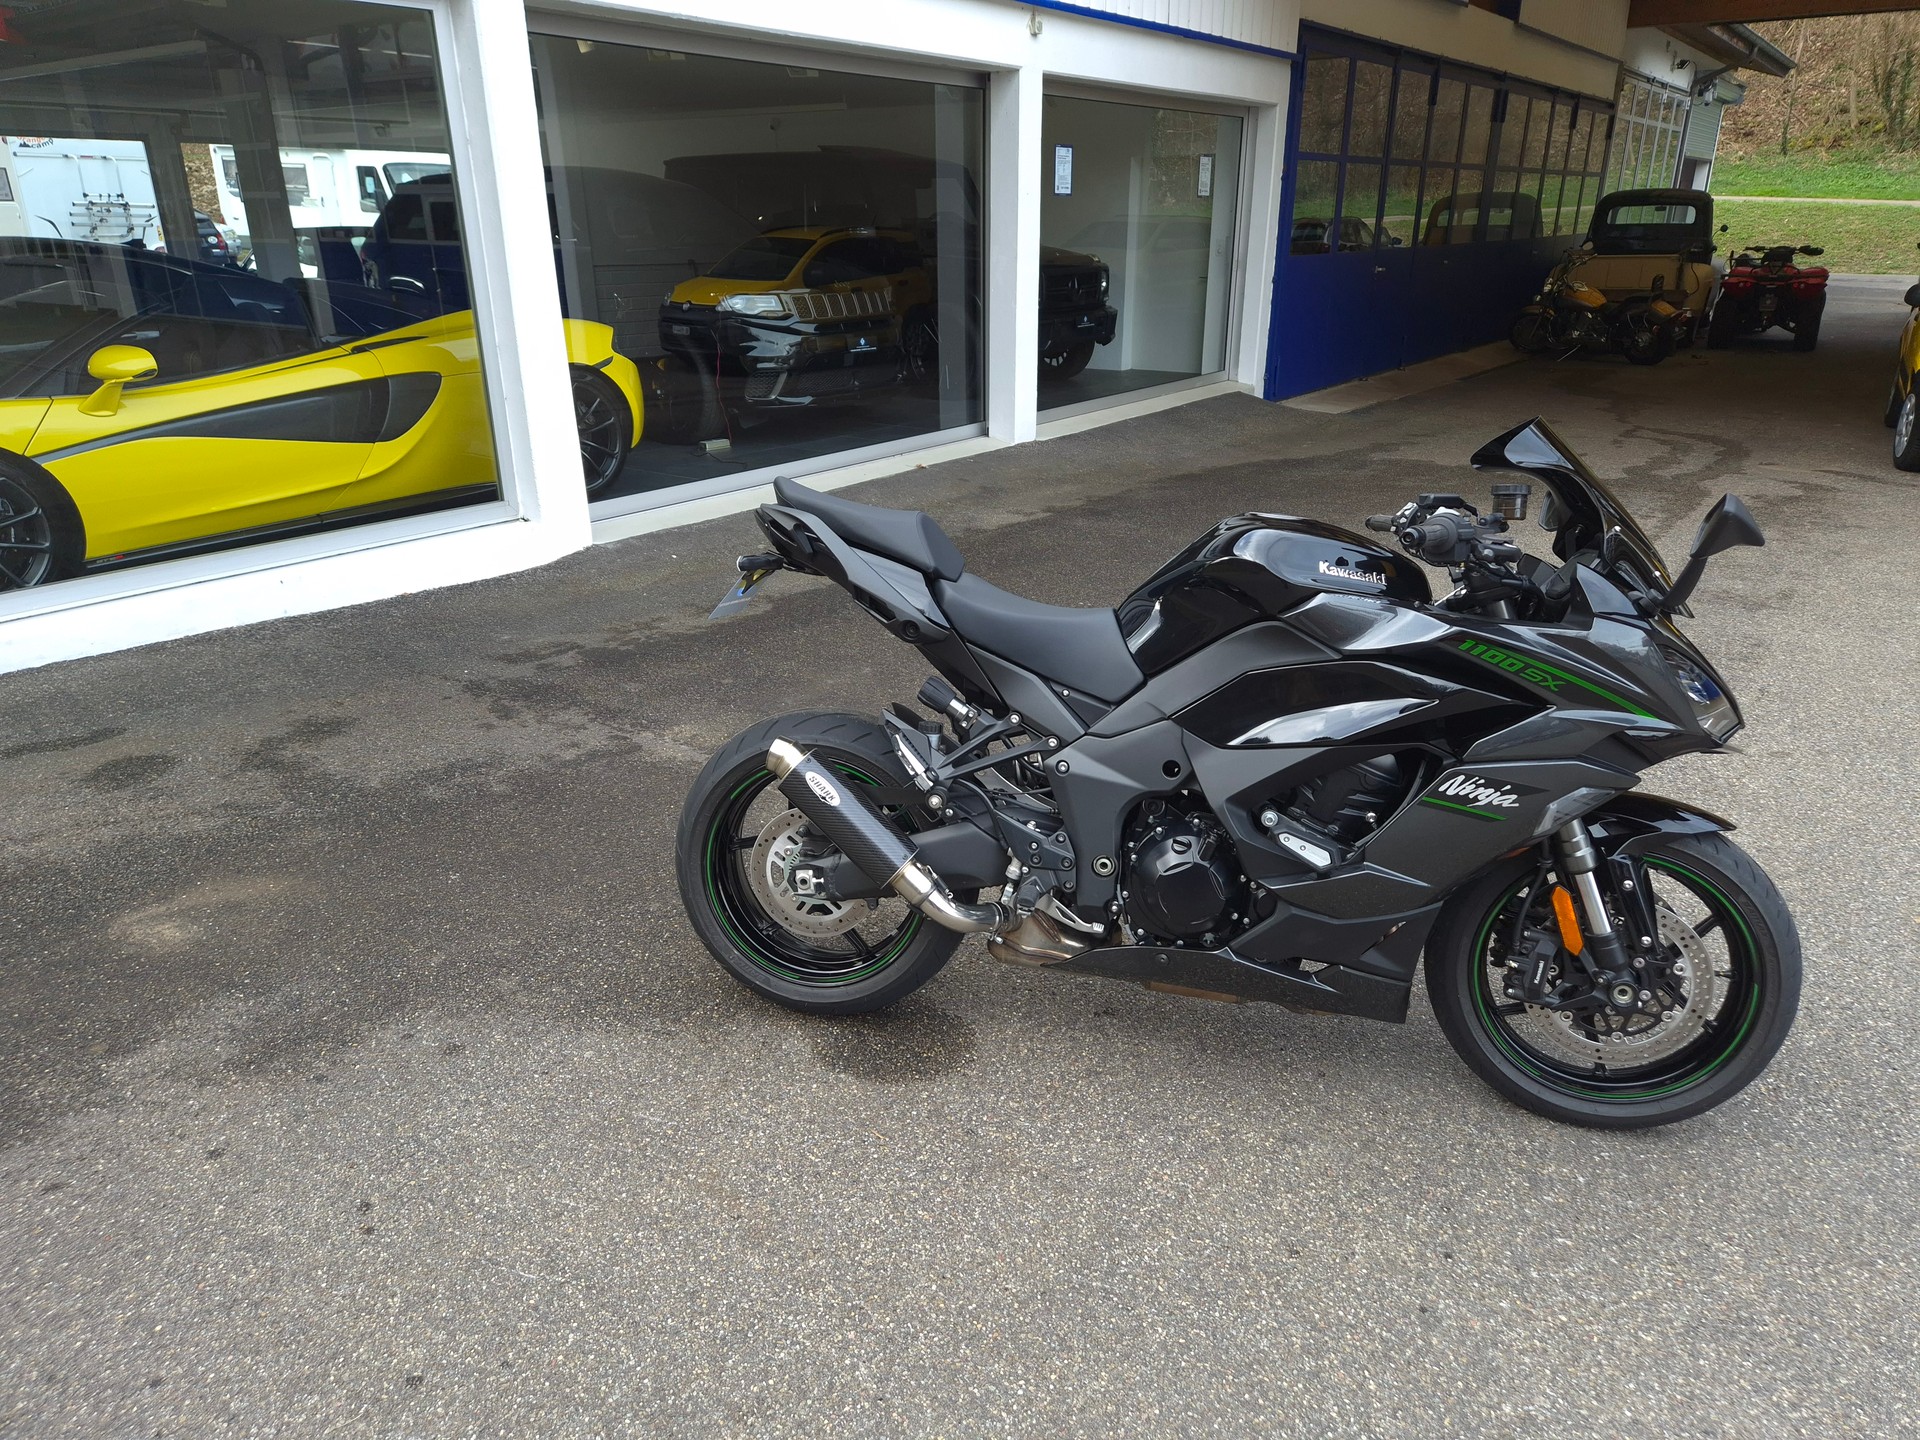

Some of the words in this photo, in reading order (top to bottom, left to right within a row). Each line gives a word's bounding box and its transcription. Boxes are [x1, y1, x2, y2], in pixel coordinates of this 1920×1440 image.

[1318, 560, 1388, 586] Kawasaki
[809, 775, 837, 802] SHARK
[1438, 774, 1520, 808] Ninja
